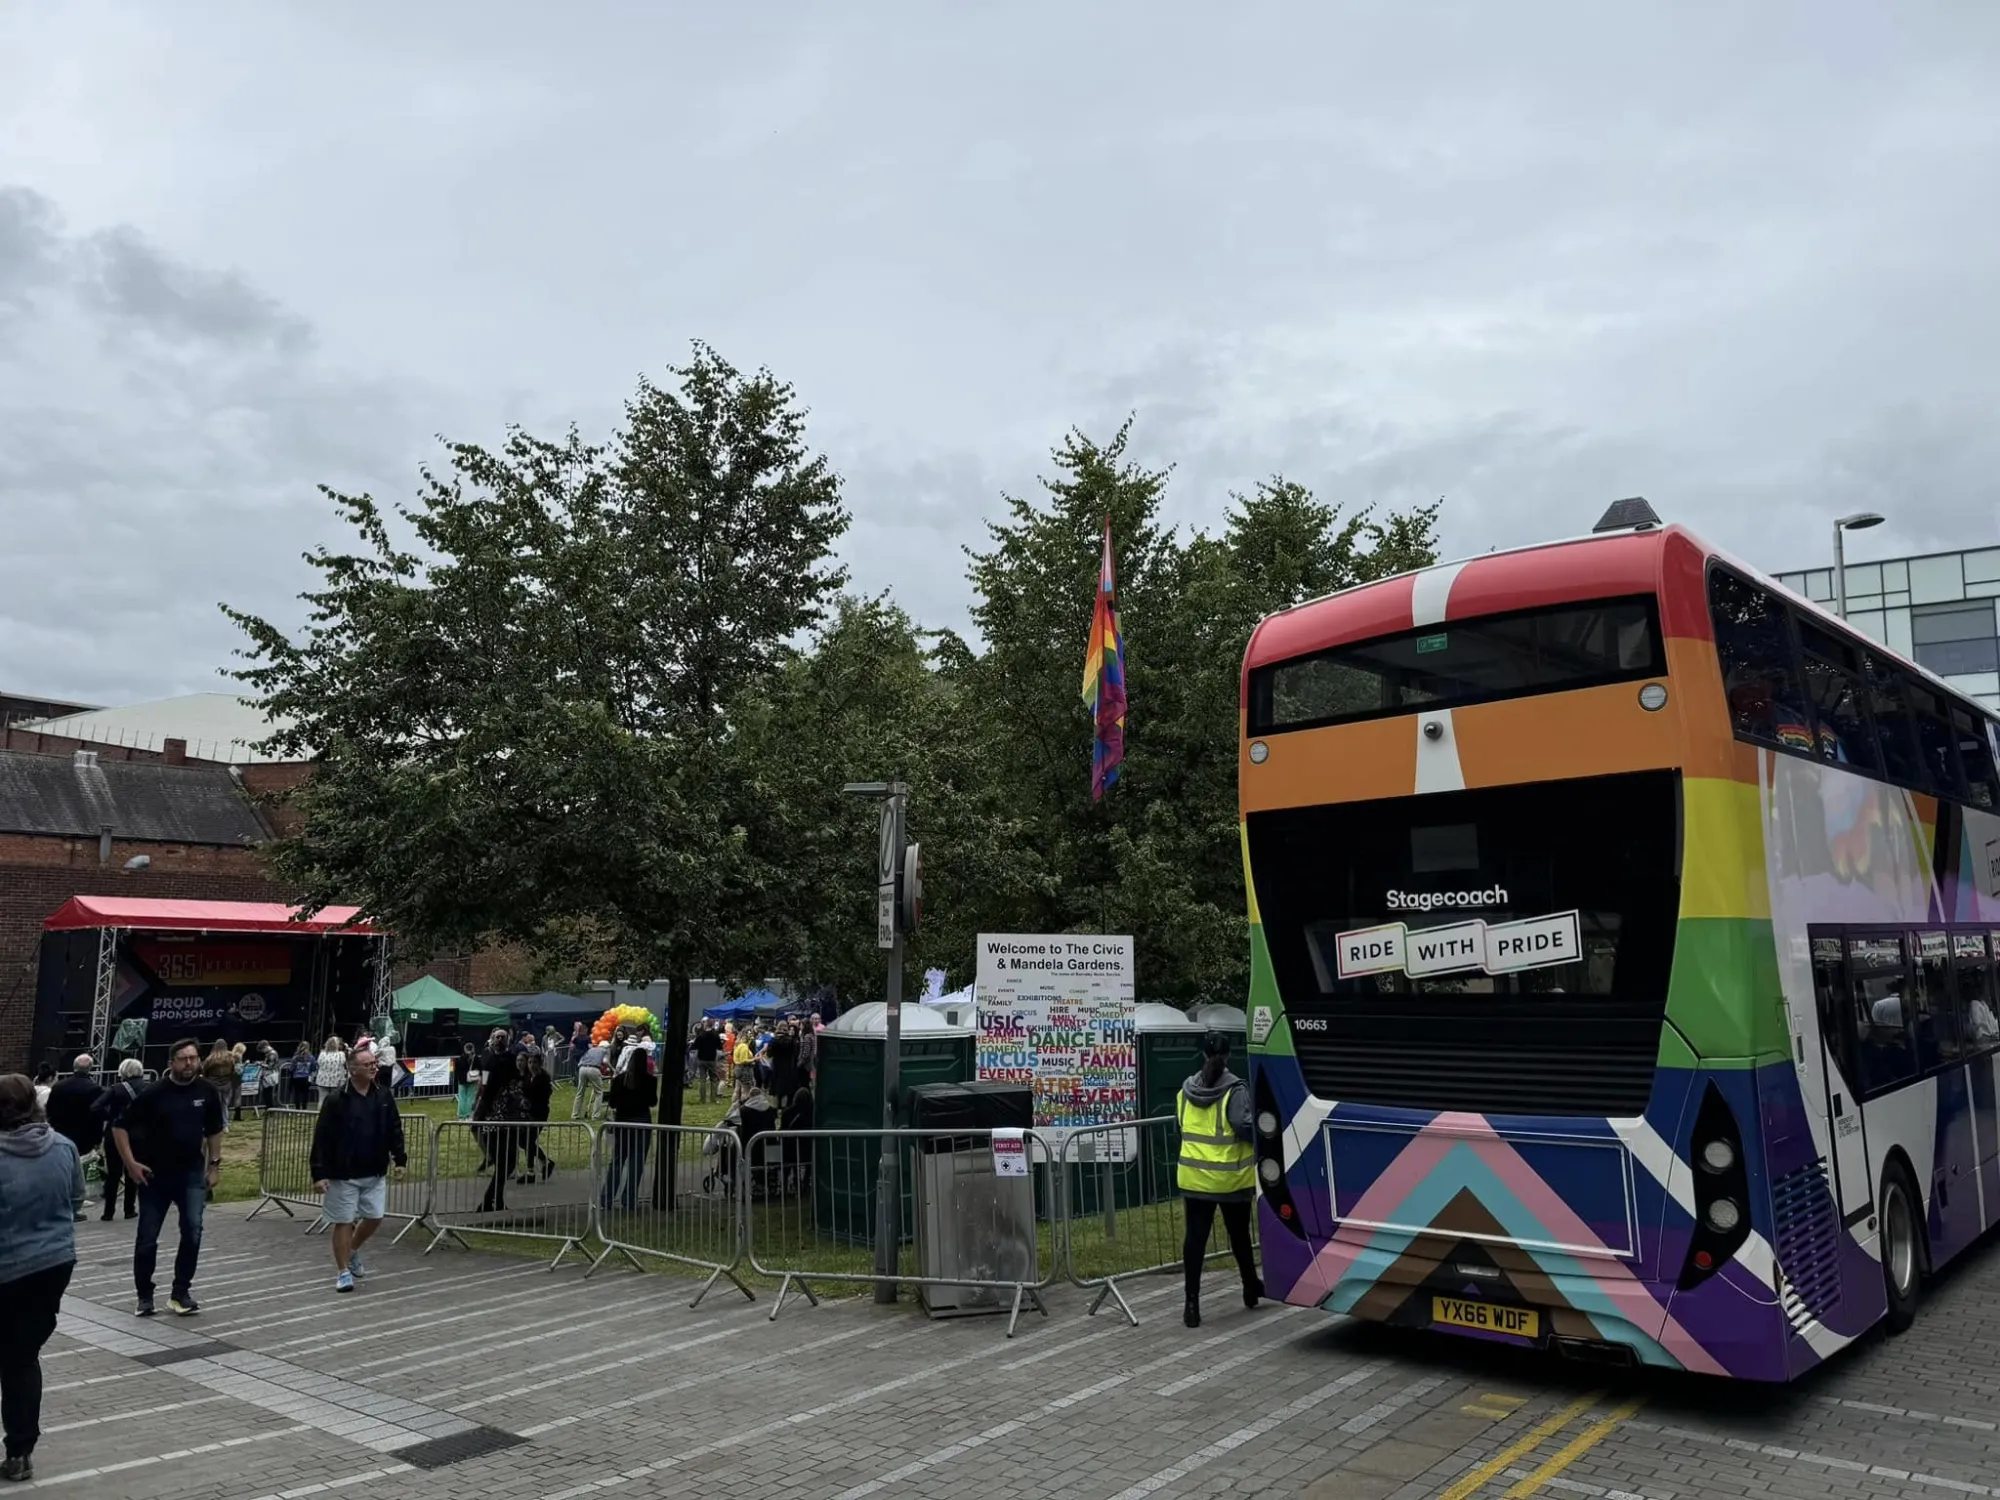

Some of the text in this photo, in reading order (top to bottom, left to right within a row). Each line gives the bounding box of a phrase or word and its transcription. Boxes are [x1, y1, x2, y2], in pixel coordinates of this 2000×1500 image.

[1386, 884, 1508, 911] Stagecoach
[988, 942, 1124, 955] Welcome to The Civic
[1350, 931, 1564, 962] RIDE WITH PRIDE
[158, 953, 196, 980] 365
[997, 958, 1124, 971] & Mandela Gardens.
[153, 996, 204, 1010] PROUD
[152, 1008, 214, 1020] SPONSORS
[1050, 1006, 1069, 1014] HIRE
[1078, 1006, 1100, 1014] MUSIC
[1053, 1018, 1086, 1027] EVENTS
[1294, 1019, 1328, 1031] 10663
[987, 1026, 1034, 1038] FAMILY
[1028, 1032, 1096, 1047] DANCE
[980, 1045, 1024, 1053] COMEDY
[1036, 1046, 1076, 1054] EVENTS
[976, 1051, 1039, 1067] IRCUS
[1042, 1058, 1074, 1066] MUSIC
[979, 1068, 1033, 1079] EVENTS
[1440, 1300, 1530, 1331] YX66 WDF
